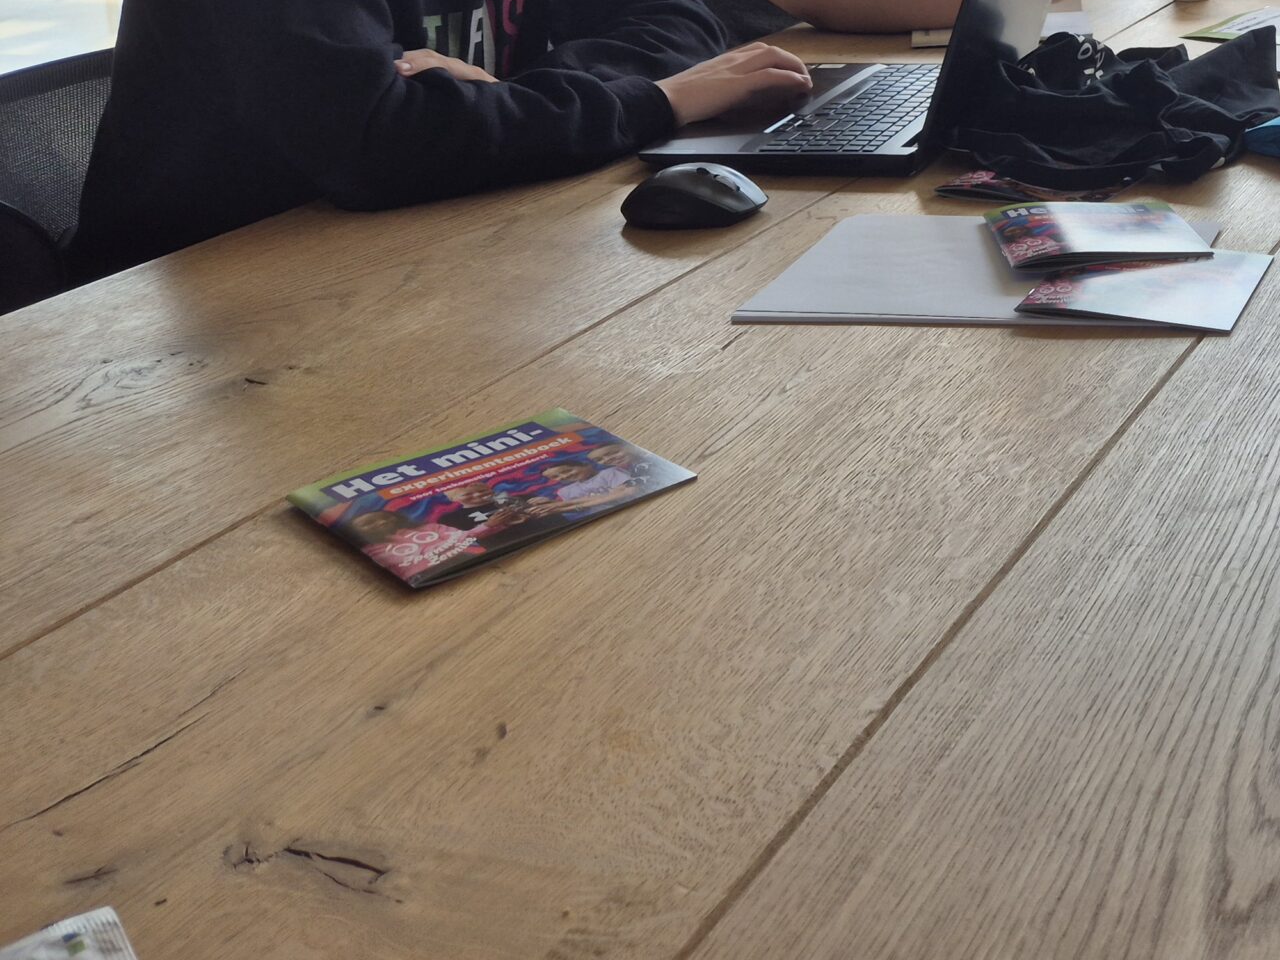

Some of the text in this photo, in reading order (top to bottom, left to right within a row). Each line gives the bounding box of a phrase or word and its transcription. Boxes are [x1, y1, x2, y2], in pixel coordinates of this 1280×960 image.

[331, 429, 543, 498] Het mini-
[390, 437, 573, 495] experimentenboek
